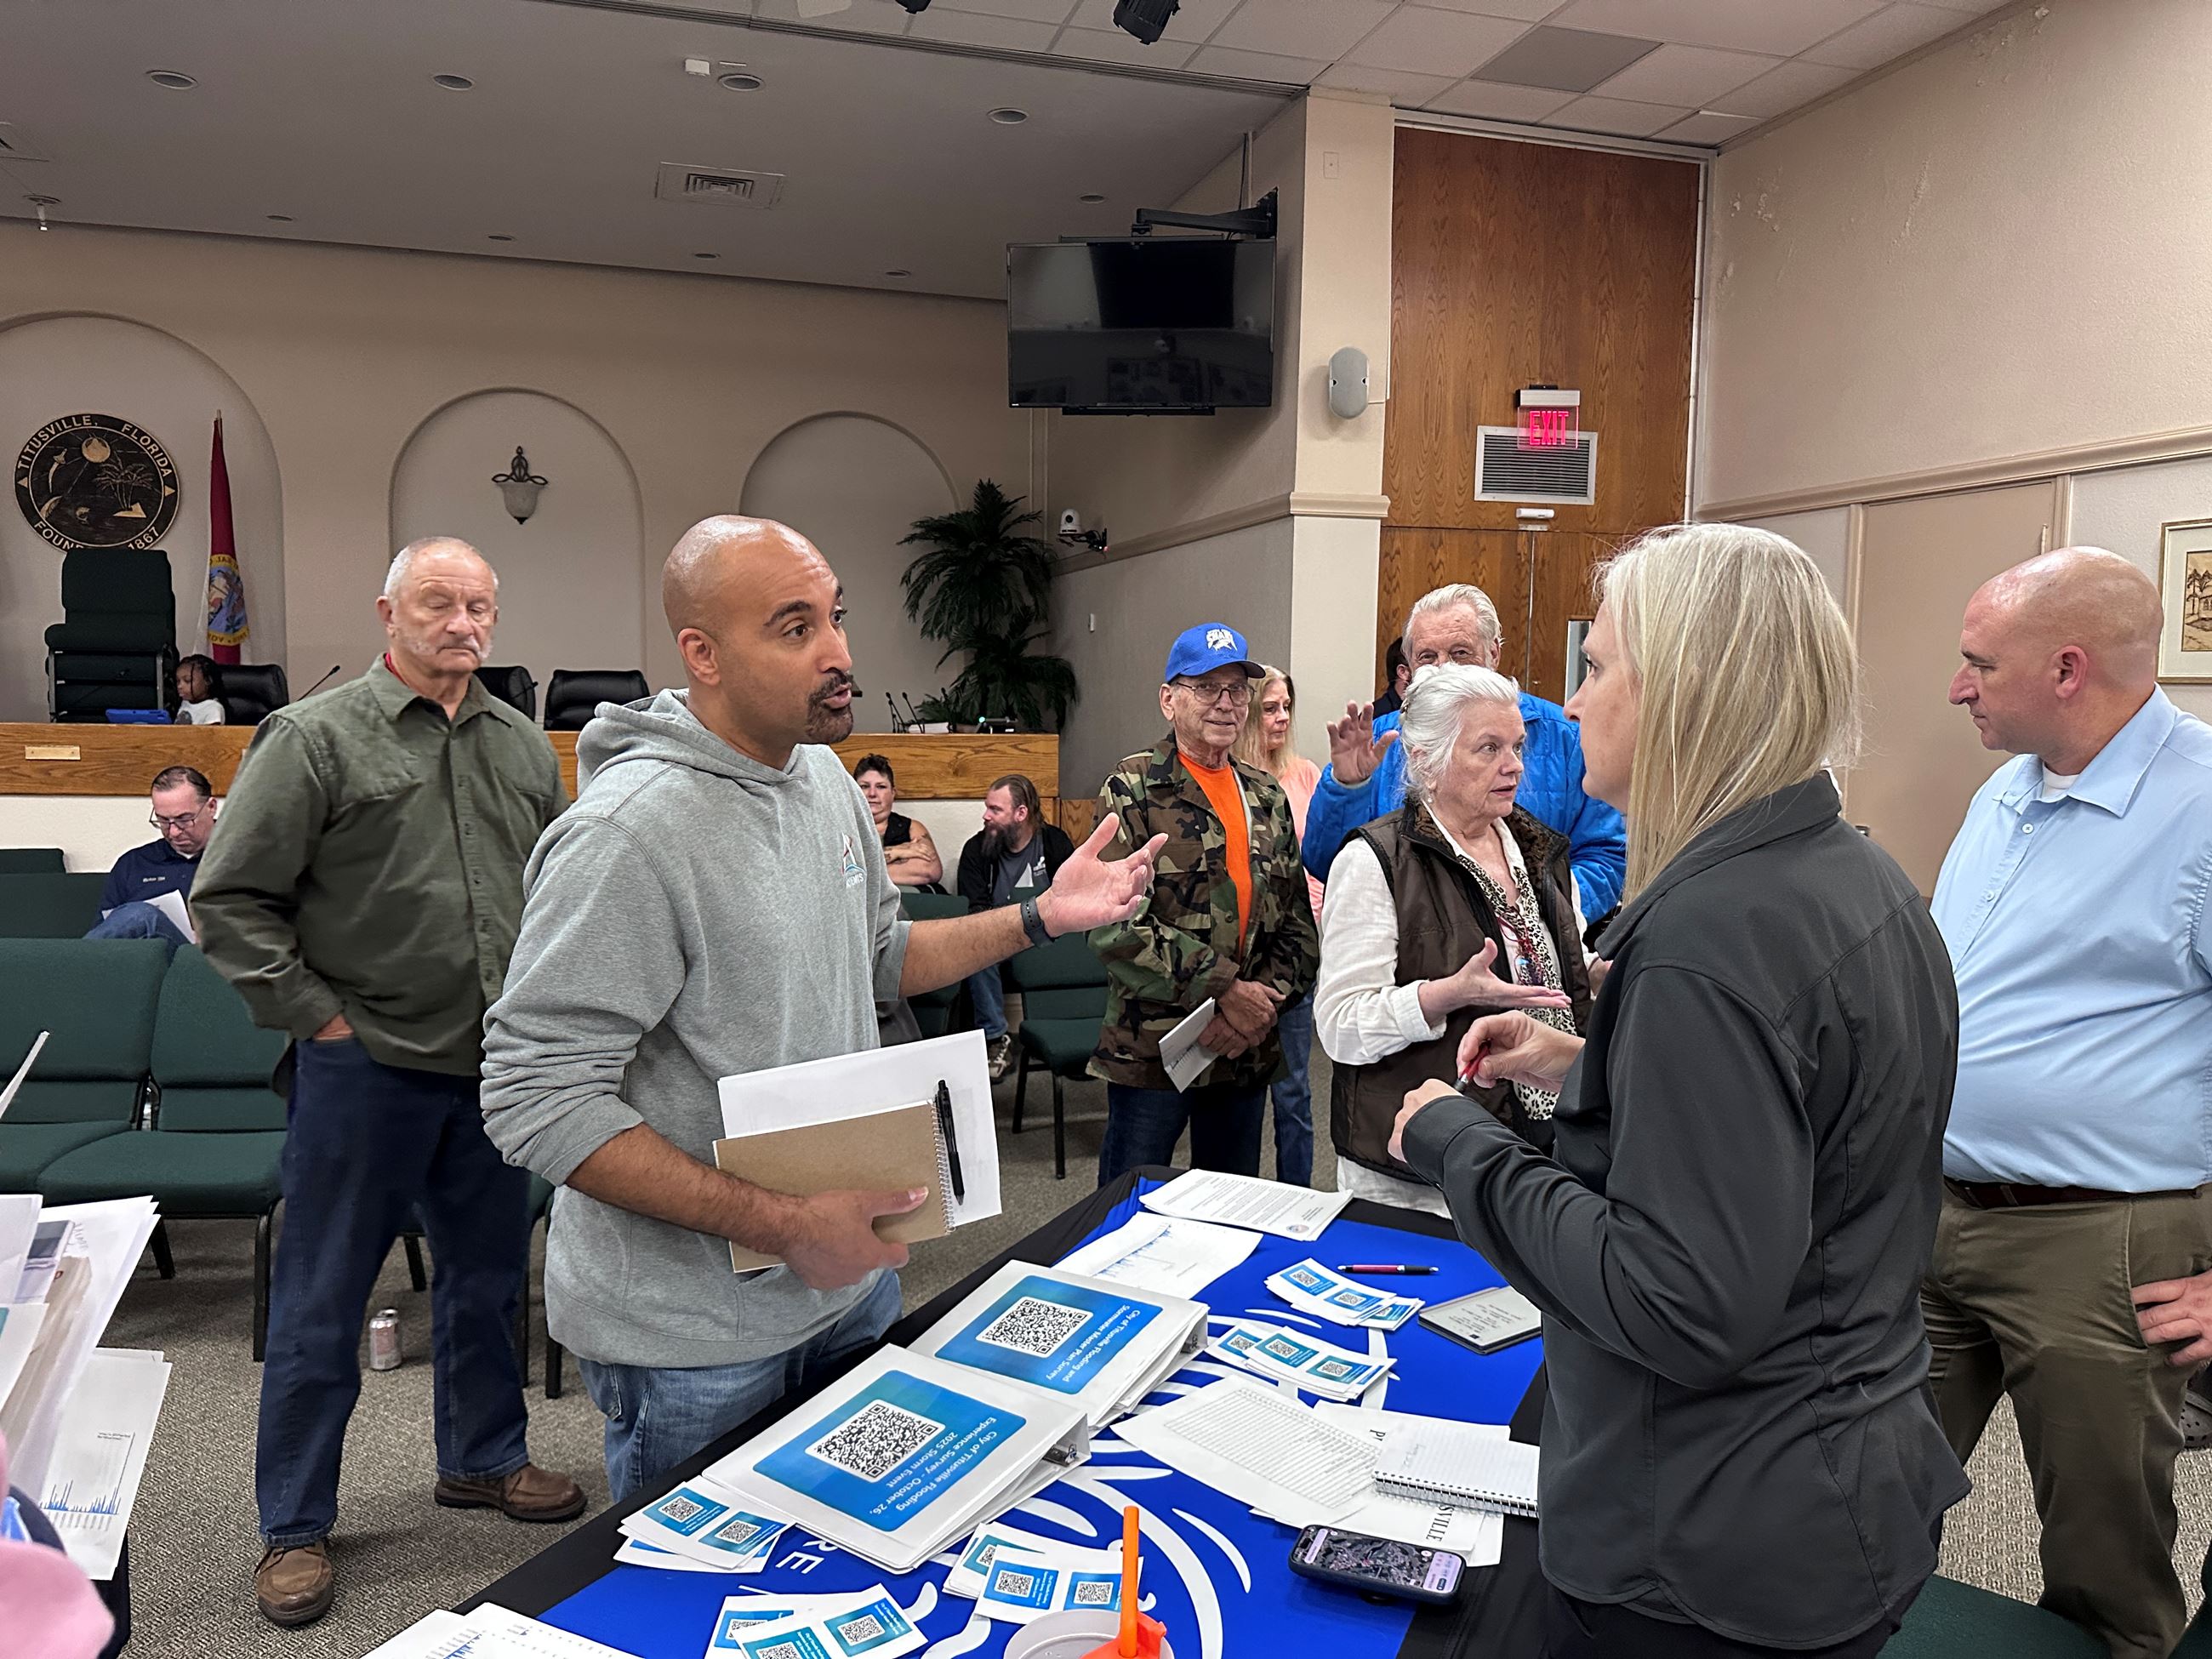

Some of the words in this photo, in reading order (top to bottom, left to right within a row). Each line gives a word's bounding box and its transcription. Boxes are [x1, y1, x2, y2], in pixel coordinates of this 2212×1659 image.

[1530, 411, 1569, 445] EXIT
[18, 415, 98, 469] TITUSVILLE,
[121, 423, 172, 477] FLORIDA
[34, 520, 84, 550] FOUN
[128, 526, 160, 550] 1867
[1045, 1360, 1070, 1381] Survey
[936, 1432, 958, 1449] 2025
[953, 1417, 997, 1450] Experience
[979, 1431, 997, 1445] City
[910, 1449, 938, 1469] Storm
[970, 1444, 980, 1454] of
[925, 1450, 956, 1474] Survey
[935, 1453, 973, 1483] Titusville
[886, 1470, 913, 1488] Event
[887, 1477, 921, 1505] October
[895, 1482, 937, 1511] Flooding
[869, 1503, 888, 1515] 26,
